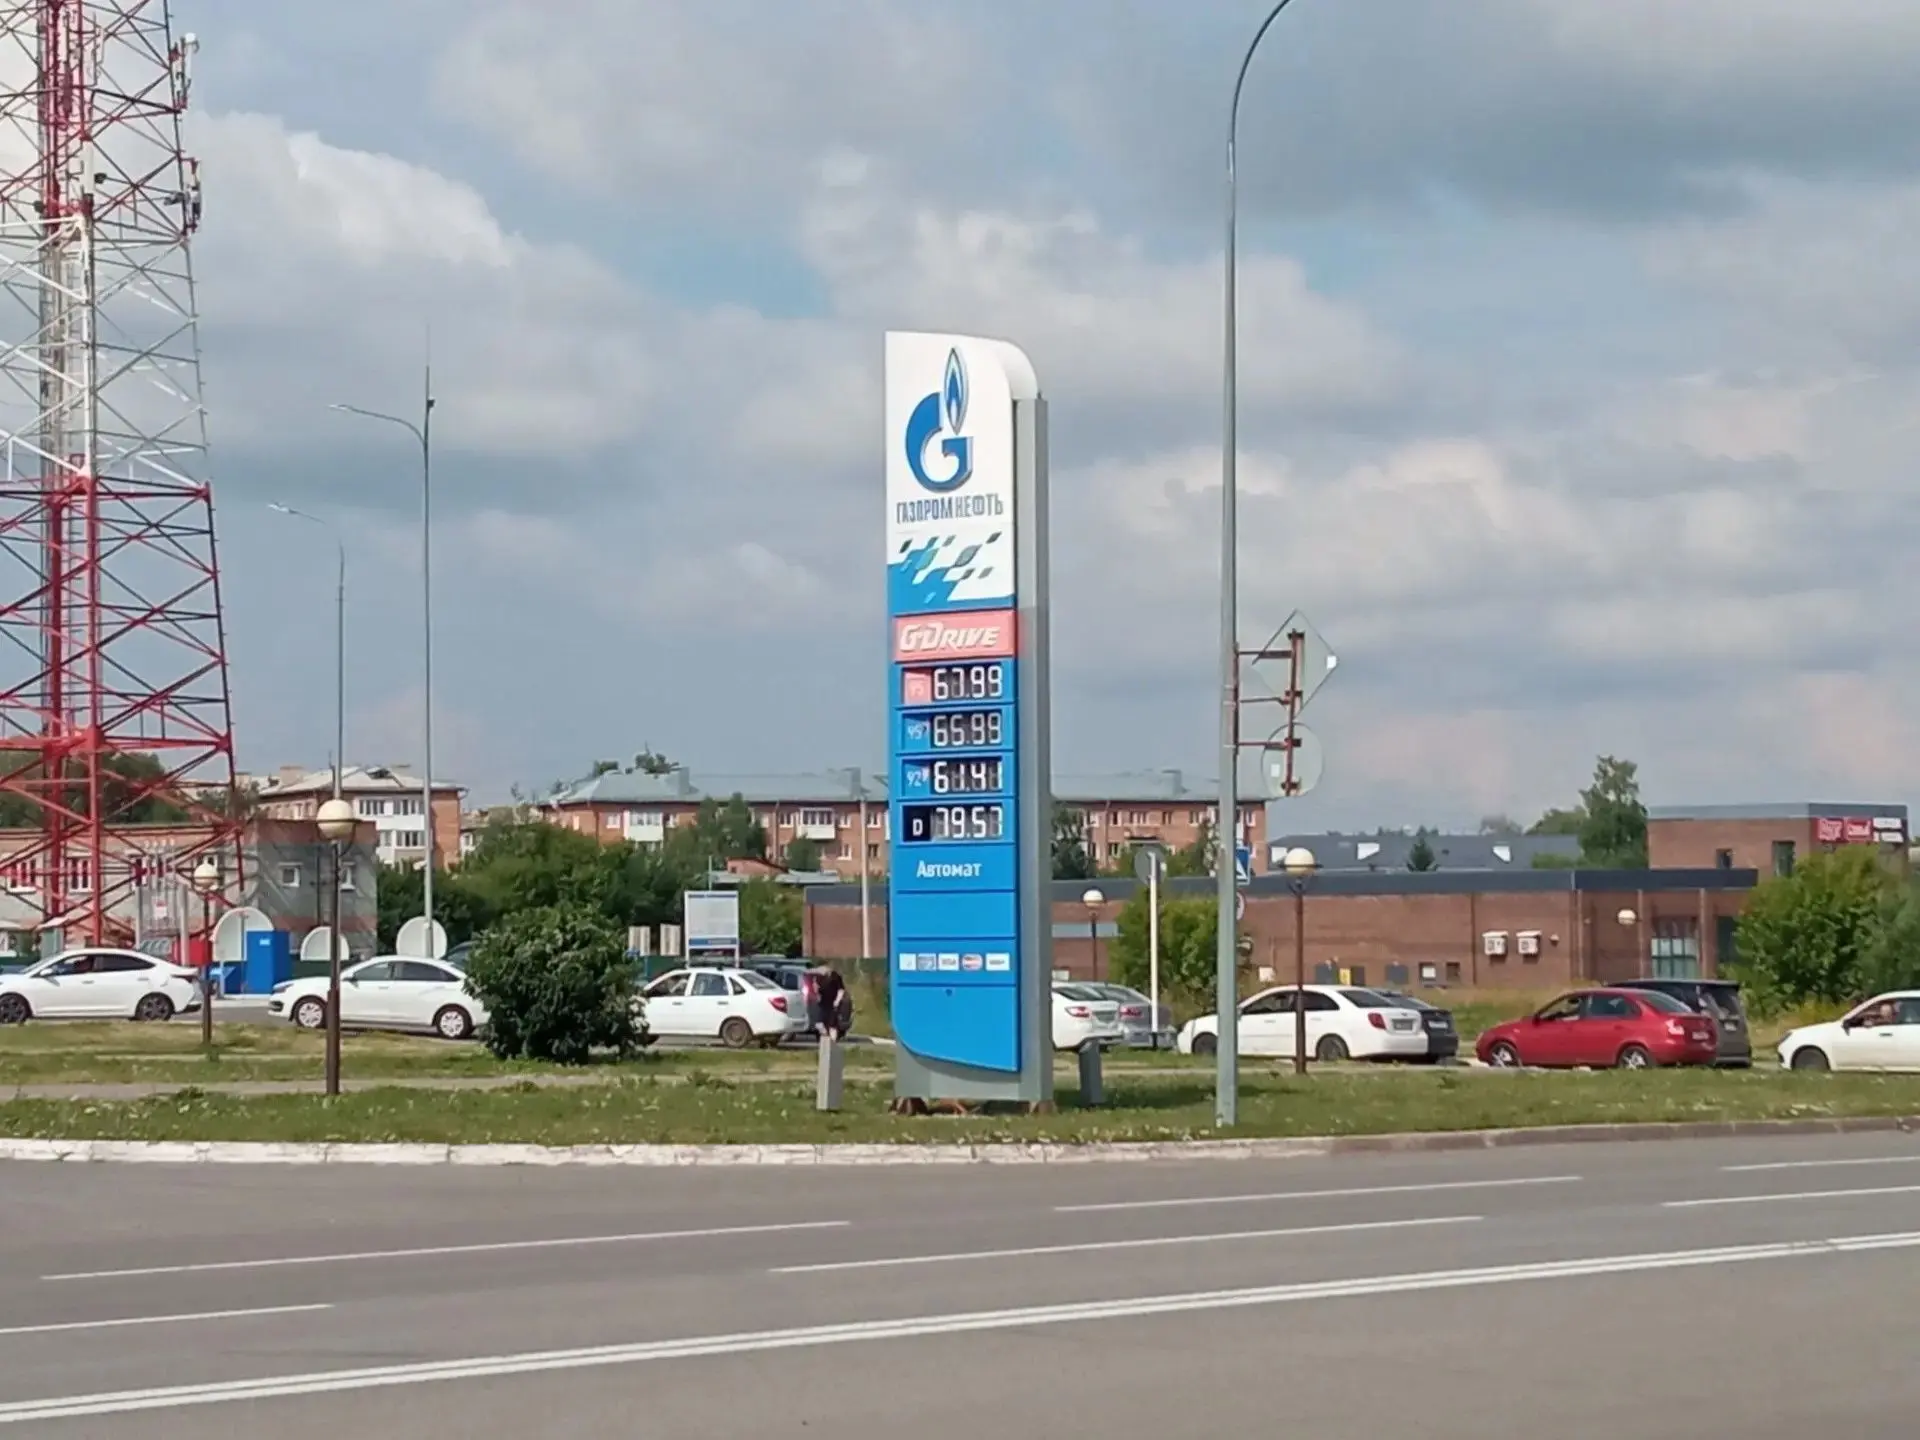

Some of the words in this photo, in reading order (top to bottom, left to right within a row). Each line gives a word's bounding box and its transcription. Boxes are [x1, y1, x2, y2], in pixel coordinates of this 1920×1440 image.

[896, 493, 1004, 524] ГАЗПРОМНЕФТЬ
[933, 665, 1003, 700] 67.99
[933, 712, 1002, 747] 65.99
[933, 760, 1003, 794] 61.41
[912, 818, 923, 836] D
[935, 806, 1003, 839] 79.57
[916, 860, 982, 878] Автомат
